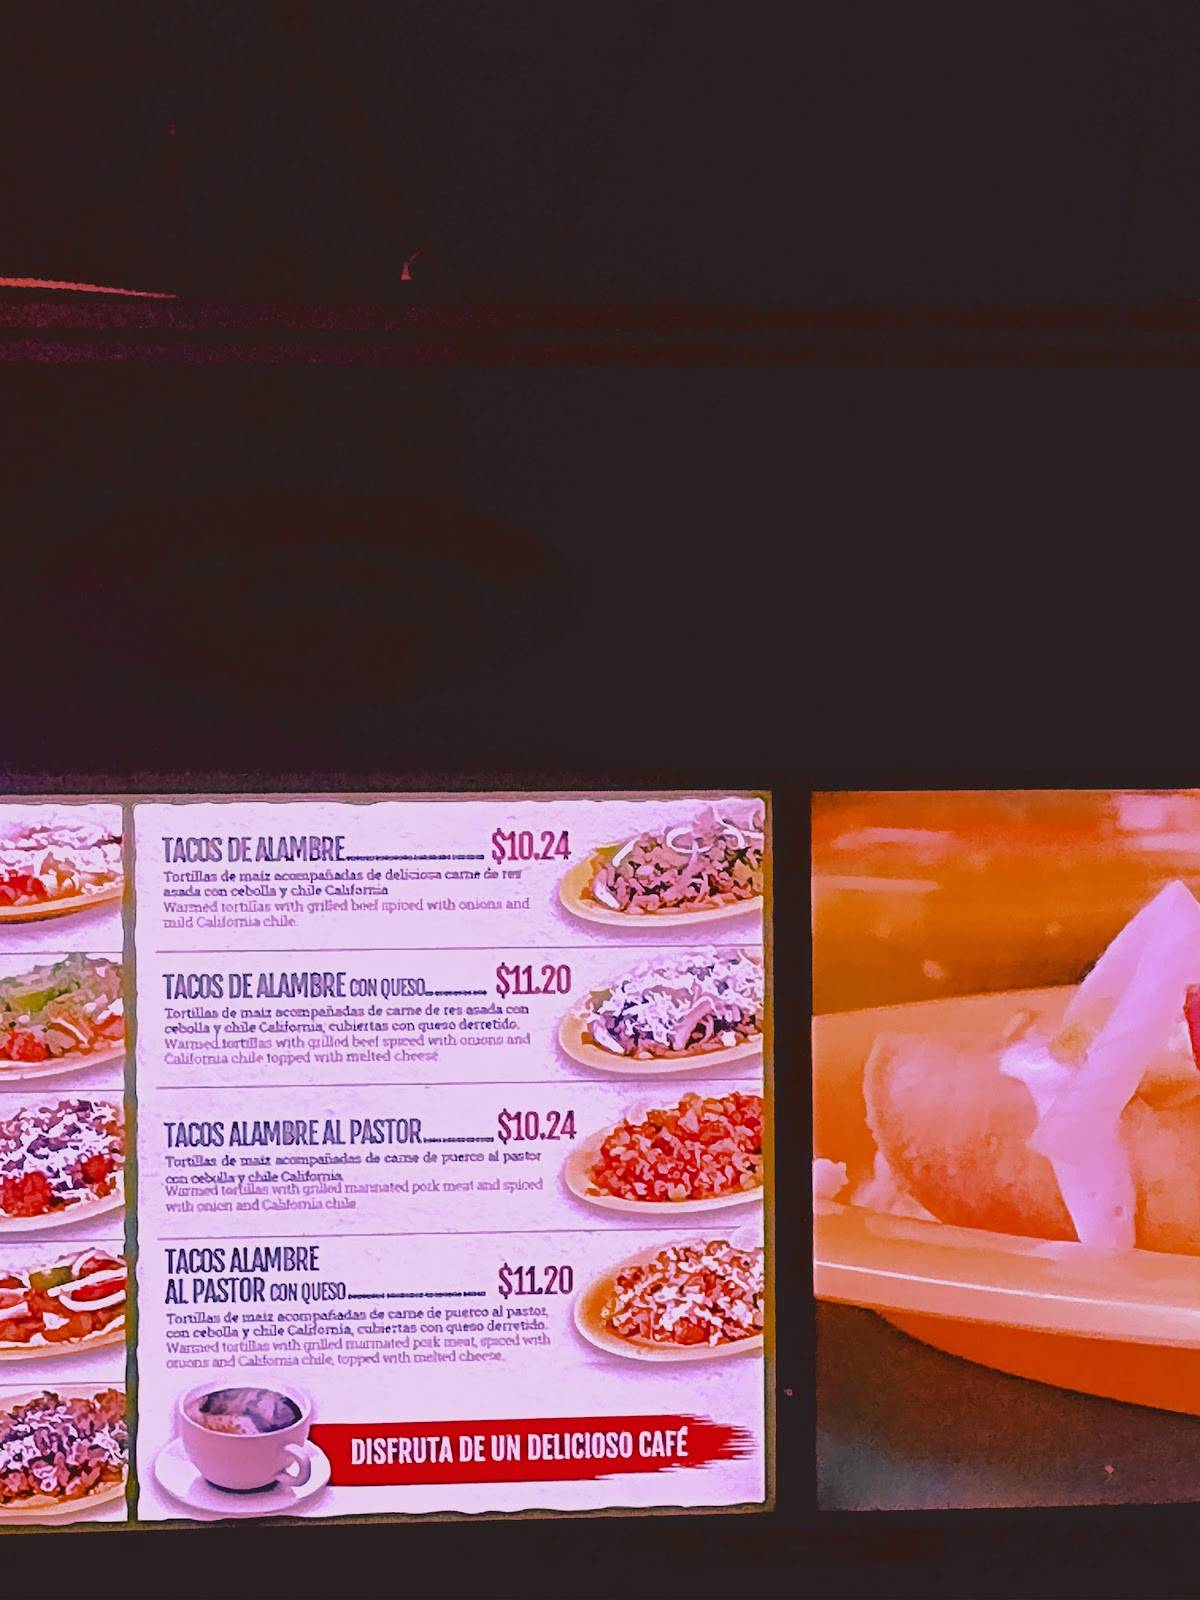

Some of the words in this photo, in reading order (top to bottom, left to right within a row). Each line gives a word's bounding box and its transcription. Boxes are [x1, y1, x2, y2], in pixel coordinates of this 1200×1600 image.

[162, 837, 223, 863] TACOS
[228, 837, 252, 863] DE
[255, 835, 346, 863] ALAMBRE
[491, 828, 571, 865] $10.24
[164, 871, 217, 882] Tortillas
[221, 870, 236, 882] de
[274, 869, 363, 883] acompañadas
[366, 869, 382, 880] de
[385, 869, 442, 880] deliciosa
[445, 870, 480, 880] carne
[484, 867, 498, 879] de
[502, 870, 522, 879] res
[164, 886, 200, 897] asada
[204, 888, 227, 896] con
[231, 886, 276, 896] cebolla
[279, 887, 287, 898] y
[291, 885, 322, 896] chile
[325, 884, 388, 895] California
[164, 901, 218, 913] Warmed
[221, 901, 271, 913] tortillas
[274, 900, 303, 912] with
[307, 899, 347, 914] grilled
[351, 899, 378, 911] beef
[382, 898, 423, 914] spiced
[427, 898, 455, 911] with
[458, 897, 502, 910] onions
[505, 898, 530, 910] and
[163, 916, 193, 928] mild
[196, 915, 260, 928] California
[162, 974, 224, 999] TACOS
[228, 973, 252, 998] DE
[256, 973, 347, 999] ALAMBRE
[350, 980, 377, 997] CON
[380, 978, 426, 998] QUESO
[496, 962, 571, 999] $11.20
[165, 1007, 218, 1019] Tortillas
[222, 1007, 237, 1018] de
[275, 1005, 364, 1020] acompañadas
[368, 1005, 382, 1016] de
[386, 1007, 421, 1016] carne
[425, 1004, 440, 1015] de
[444, 1005, 463, 1015] res
[466, 1003, 503, 1014] asada
[506, 1006, 529, 1014] con
[165, 1023, 209, 1034] cebolla
[224, 1022, 256, 1033] chile
[328, 1020, 388, 1032] cubiertas
[392, 1021, 414, 1031] con
[418, 1020, 455, 1033] queso
[165, 1038, 218, 1050] Warmed
[222, 1038, 272, 1049] tortillas
[275, 1036, 304, 1048] with
[308, 1036, 348, 1050] grilled
[352, 1035, 379, 1047] beef
[382, 1035, 424, 1048] spiced
[428, 1034, 456, 1046] with
[460, 1035, 503, 1045] onions
[506, 1033, 531, 1045] and
[165, 1053, 228, 1065] California
[231, 1053, 263, 1064] chile
[267, 1052, 310, 1066] topped
[314, 1051, 343, 1063] with
[346, 1050, 390, 1063] melted
[164, 1122, 224, 1148] TACOS
[229, 1120, 318, 1146] ALAMBRE
[322, 1120, 346, 1145] AL
[350, 1119, 423, 1145] PASTOR
[498, 1108, 577, 1145] $10.24
[165, 1155, 216, 1168] Tortillas
[221, 1155, 236, 1167] de
[276, 1153, 361, 1167] acompañadas
[366, 1152, 380, 1163] de
[384, 1155, 419, 1163] carne
[423, 1152, 437, 1163] de
[442, 1152, 484, 1165] puerco
[488, 1151, 499, 1161] al
[503, 1151, 541, 1164] pastor
[166, 1176, 187, 1184] con
[190, 1172, 235, 1183] cebolla
[248, 1172, 278, 1182] chile
[281, 1170, 343, 1182] California
[165, 1185, 218, 1197] Warmed
[221, 1184, 268, 1195] tortillas
[272, 1183, 299, 1195] with
[303, 1182, 341, 1196] grilled
[412, 1180, 440, 1195] pork
[443, 1180, 473, 1191] meat
[477, 1179, 500, 1191] and
[503, 1177, 543, 1193] spiced
[166, 1201, 194, 1213] with
[197, 1202, 232, 1212] onion
[236, 1200, 259, 1211] and
[262, 1198, 322, 1211] California
[165, 1247, 225, 1274] TACOS
[230, 1246, 320, 1273] ALAMBRE
[165, 1278, 188, 1304] AL
[192, 1277, 265, 1303] PASTOR
[270, 1284, 298, 1302] CON
[301, 1282, 346, 1302] QUESO
[498, 1263, 573, 1300] $11.20
[166, 1312, 221, 1324] Tortillas
[224, 1312, 238, 1323] de
[278, 1310, 366, 1324] acompañadas
[369, 1308, 384, 1319] de
[388, 1310, 424, 1319] carne
[427, 1307, 441, 1318] de
[445, 1308, 489, 1320] puerco
[492, 1305, 503, 1317] al
[166, 1329, 189, 1338] con
[193, 1327, 238, 1337] cebolla
[242, 1328, 250, 1339] y
[253, 1325, 283, 1336] chile
[357, 1323, 417, 1334] cubiertas
[420, 1324, 443, 1333] con
[446, 1323, 484, 1334] queso
[166, 1342, 219, 1353] Warmed
[222, 1340, 270, 1352] tortillas
[272, 1339, 300, 1351] with
[303, 1338, 342, 1353] grilled
[413, 1337, 440, 1350] pork
[523, 1332, 551, 1345] with
[166, 1360, 209, 1368] onions
[212, 1356, 235, 1367] and
[238, 1355, 299, 1367] California
[337, 1353, 380, 1366] topped
[383, 1351, 410, 1363] with
[414, 1350, 456, 1363] melted
[351, 1436, 453, 1465] DISFRUTA
[459, 1435, 485, 1462] DE
[491, 1434, 521, 1462] UN
[527, 1432, 633, 1461] DELICIOSO
[639, 1425, 689, 1458] CAFÉ
